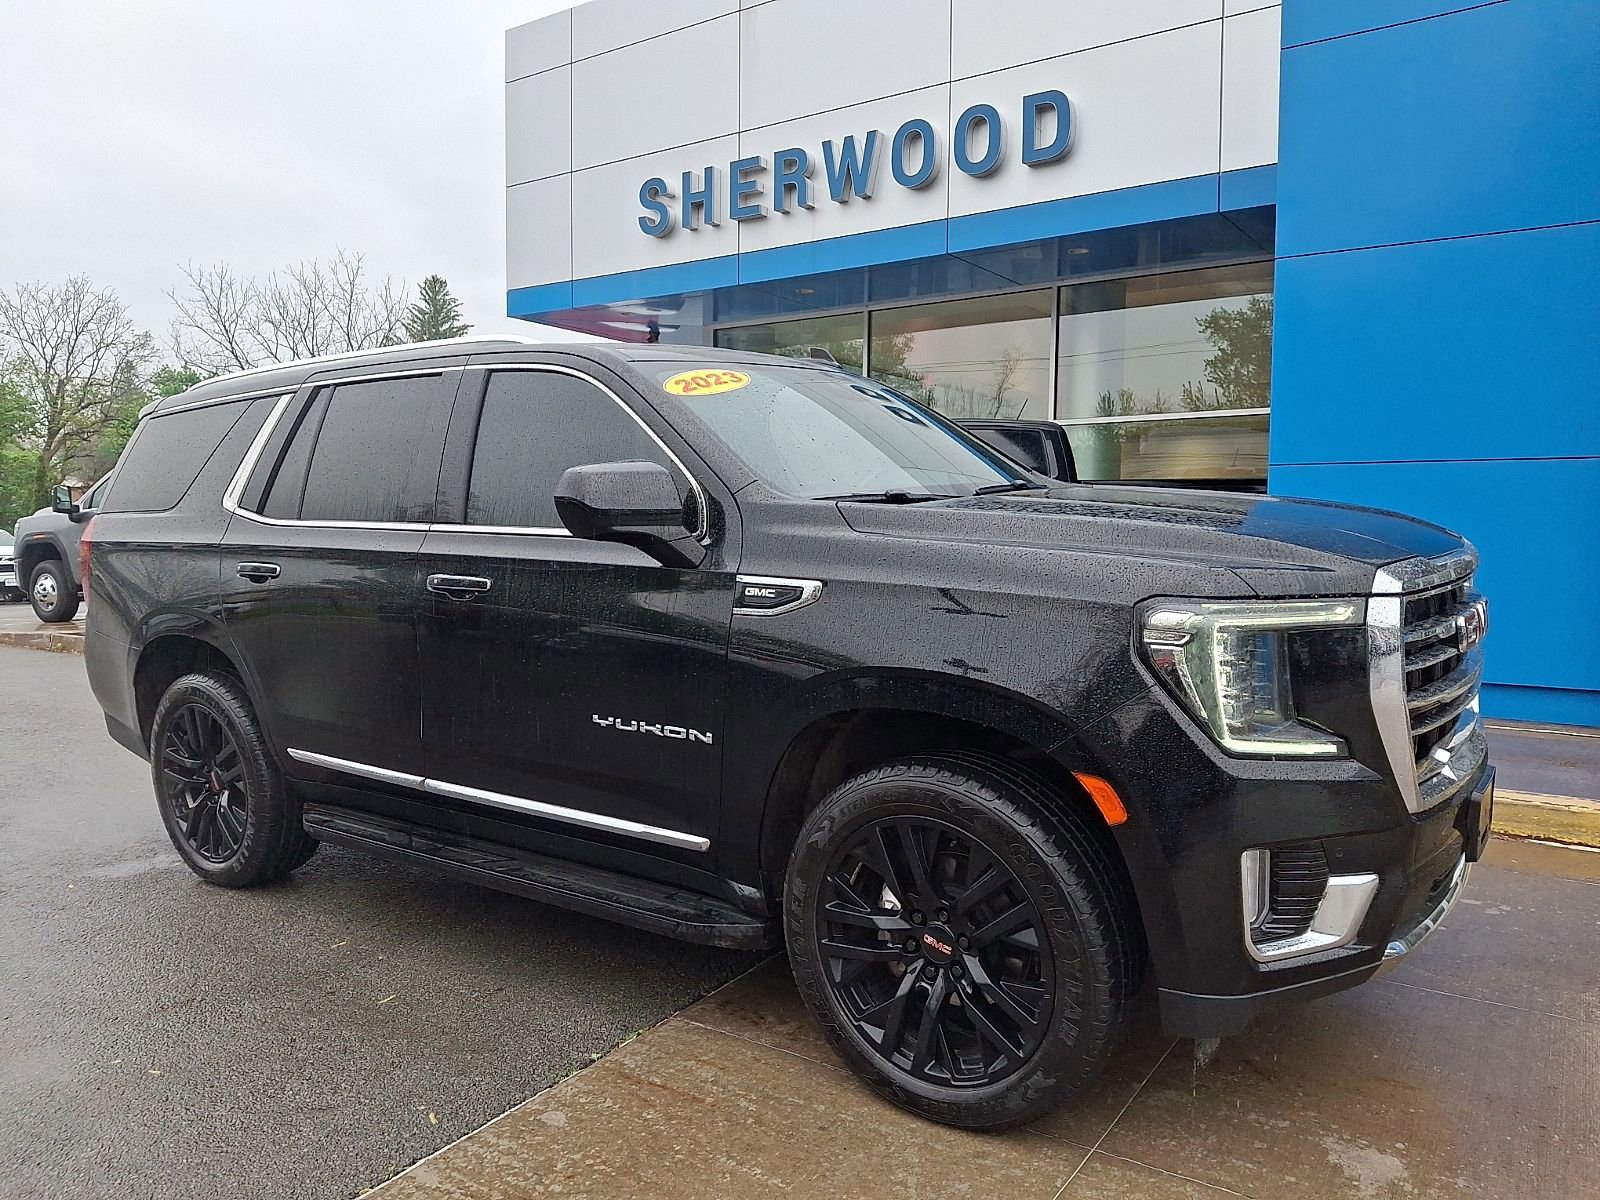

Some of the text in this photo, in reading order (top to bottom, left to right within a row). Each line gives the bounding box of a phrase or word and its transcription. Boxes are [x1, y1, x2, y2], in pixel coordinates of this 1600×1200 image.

[637, 88, 1076, 239] SHERWOOD
[674, 371, 743, 394] 2023
[744, 587, 776, 598] GMC
[592, 714, 713, 745] YUKON
[923, 933, 953, 956] GMC
